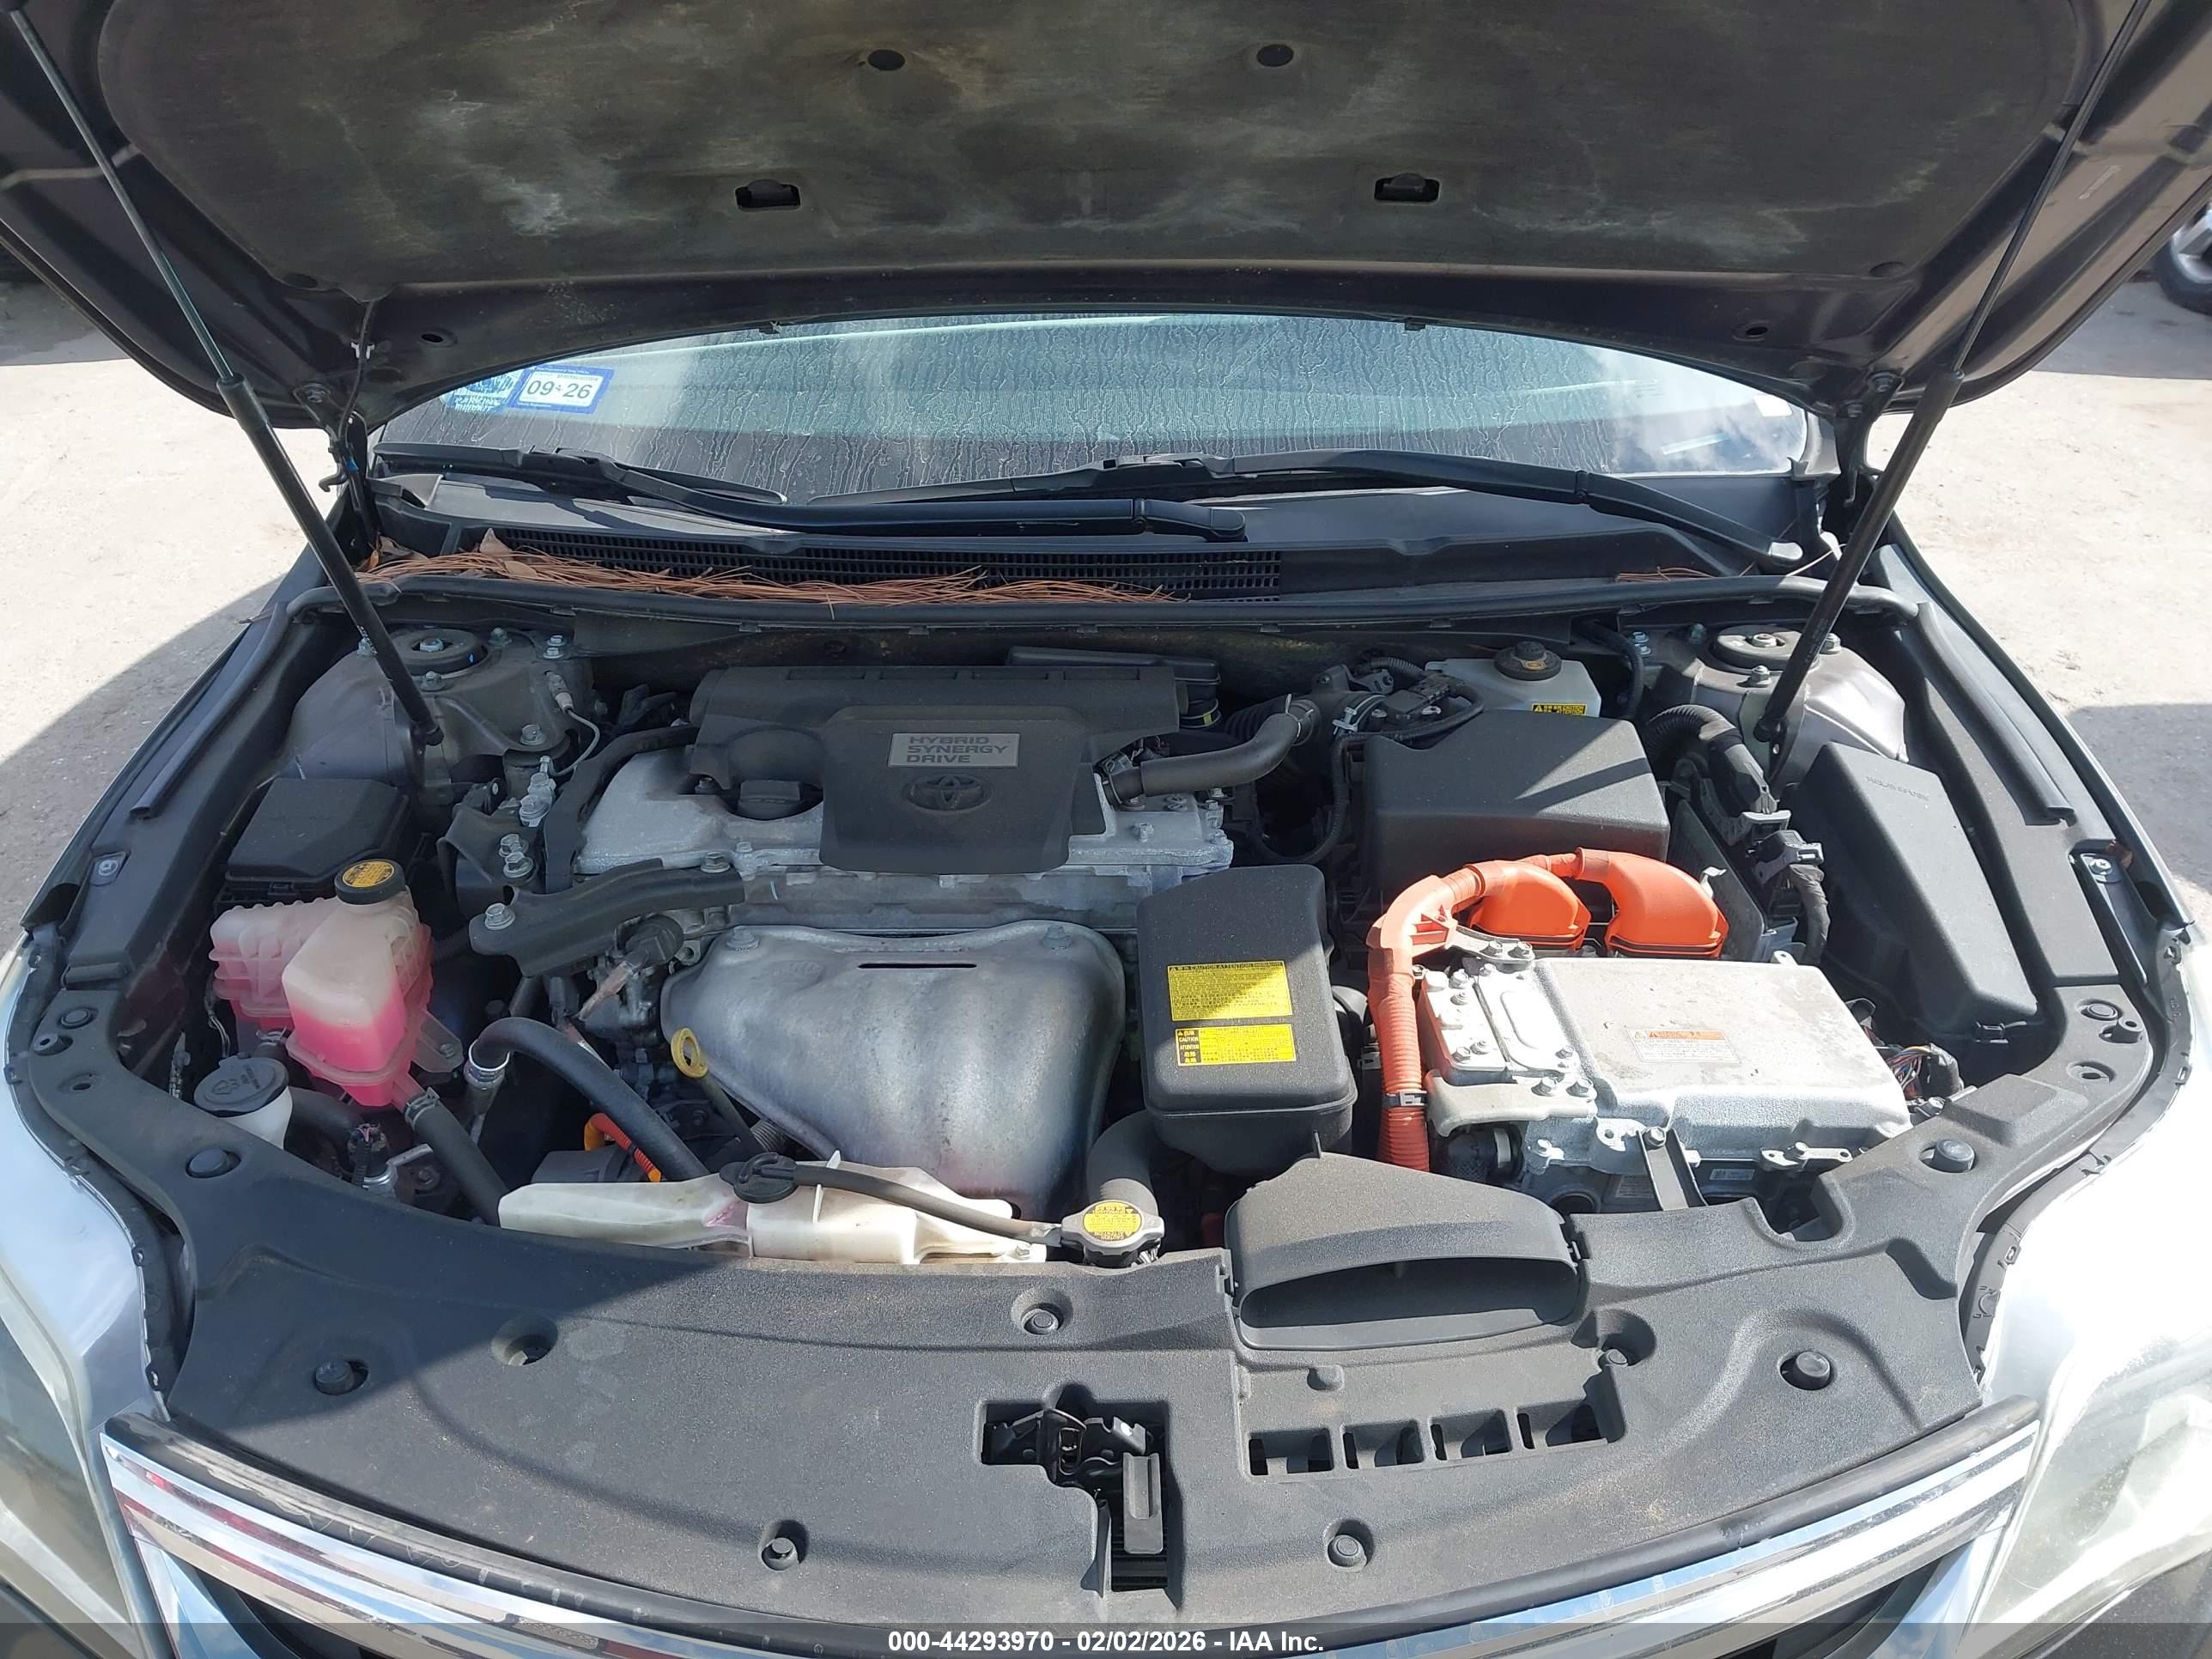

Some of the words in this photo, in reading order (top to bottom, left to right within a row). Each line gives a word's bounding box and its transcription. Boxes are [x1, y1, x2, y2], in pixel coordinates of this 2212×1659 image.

[526, 380, 555, 396] 09
[563, 383, 592, 398] 26
[909, 736, 990, 744] HYBRID
[907, 745, 1008, 754] SYNERGY
[906, 755, 971, 763] DRIVE
